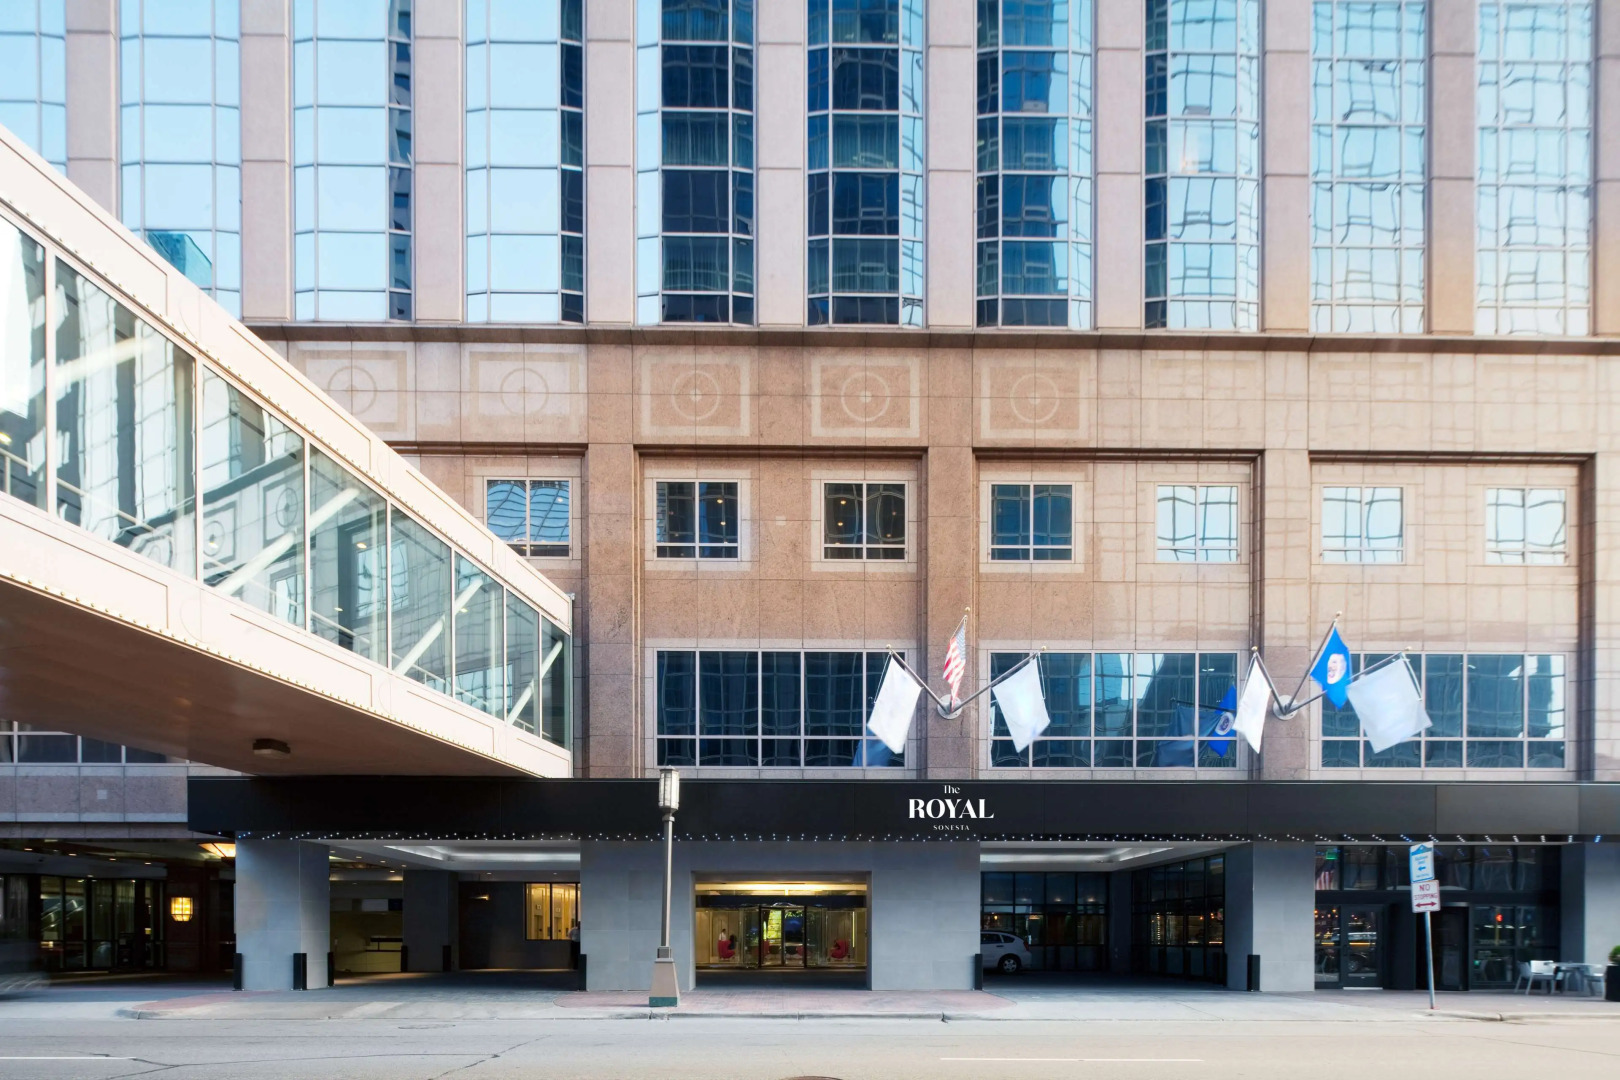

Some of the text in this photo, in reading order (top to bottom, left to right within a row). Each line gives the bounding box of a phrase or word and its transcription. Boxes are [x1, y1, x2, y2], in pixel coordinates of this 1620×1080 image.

[943, 785, 961, 794] The
[909, 799, 995, 818] ROYAL
[1419, 884, 1431, 892] NO
